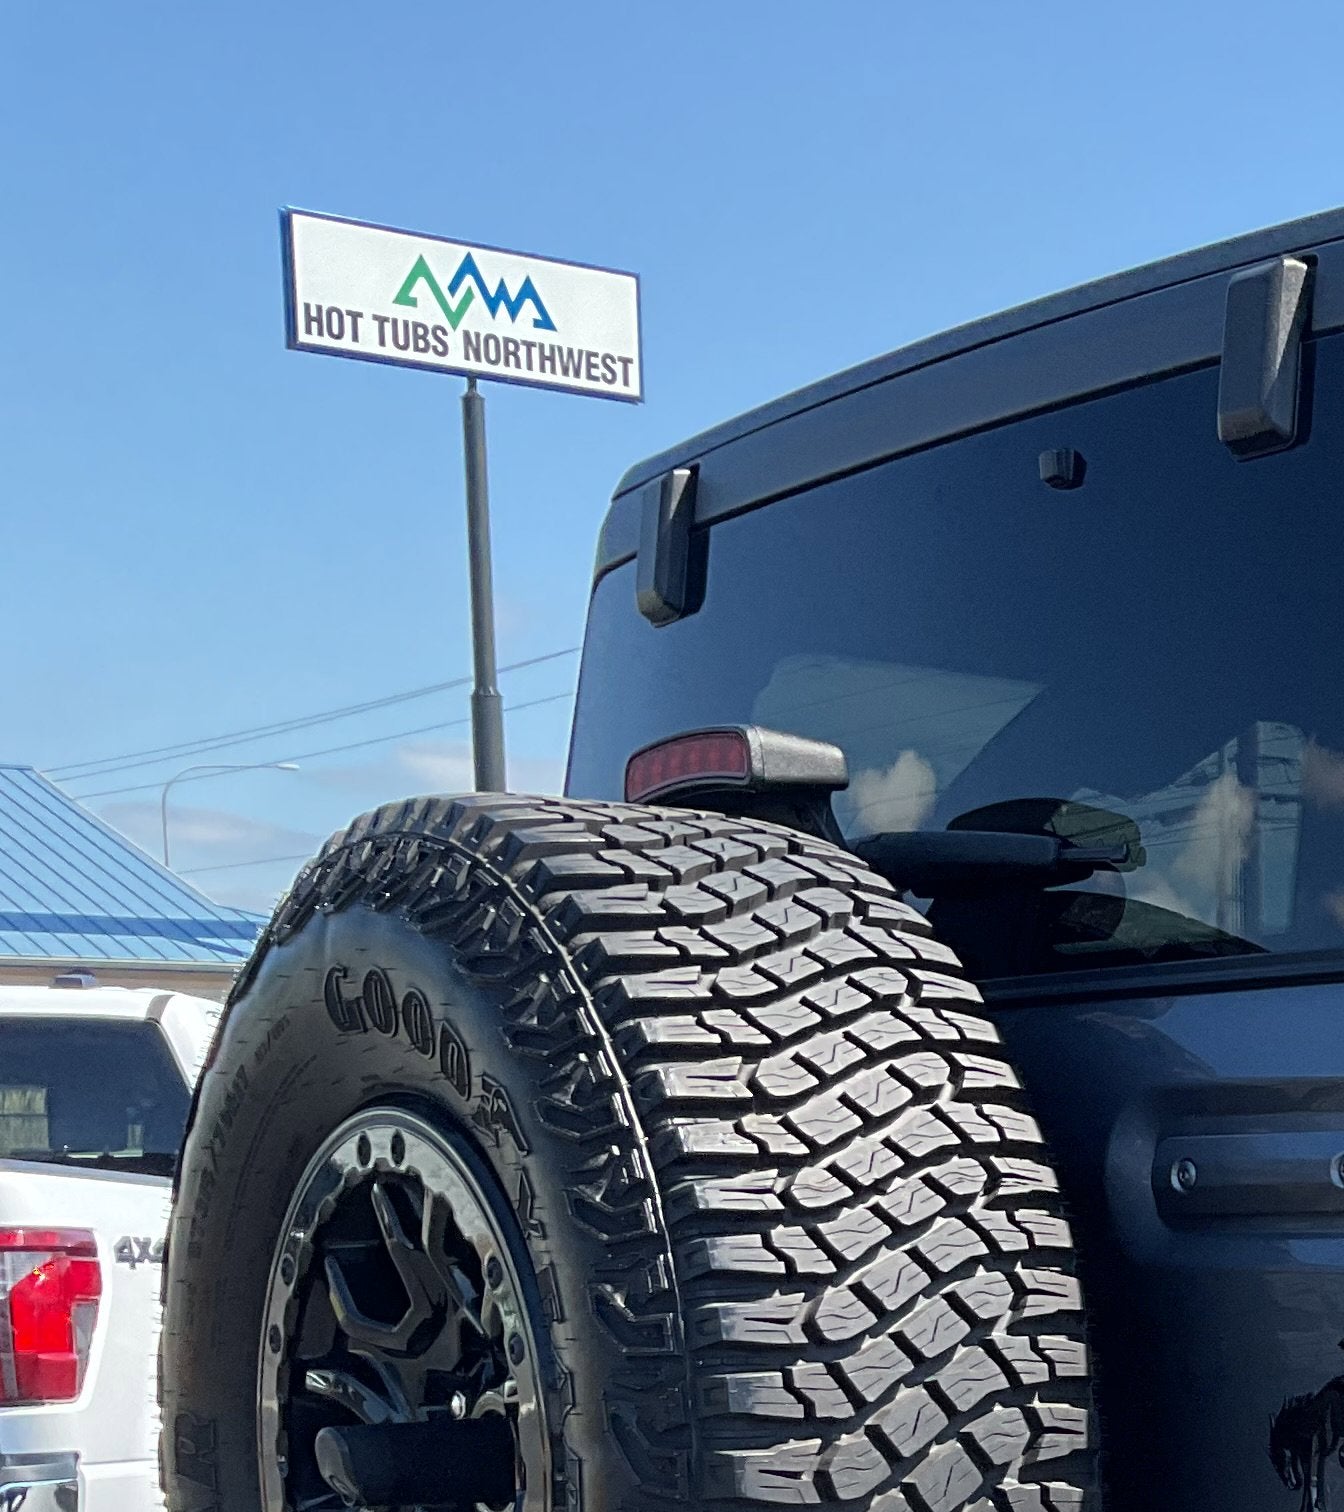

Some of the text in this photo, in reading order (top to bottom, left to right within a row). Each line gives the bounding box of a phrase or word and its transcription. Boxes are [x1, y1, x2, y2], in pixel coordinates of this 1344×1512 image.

[303, 302, 634, 388] HOT TUBS NORTHWEST
